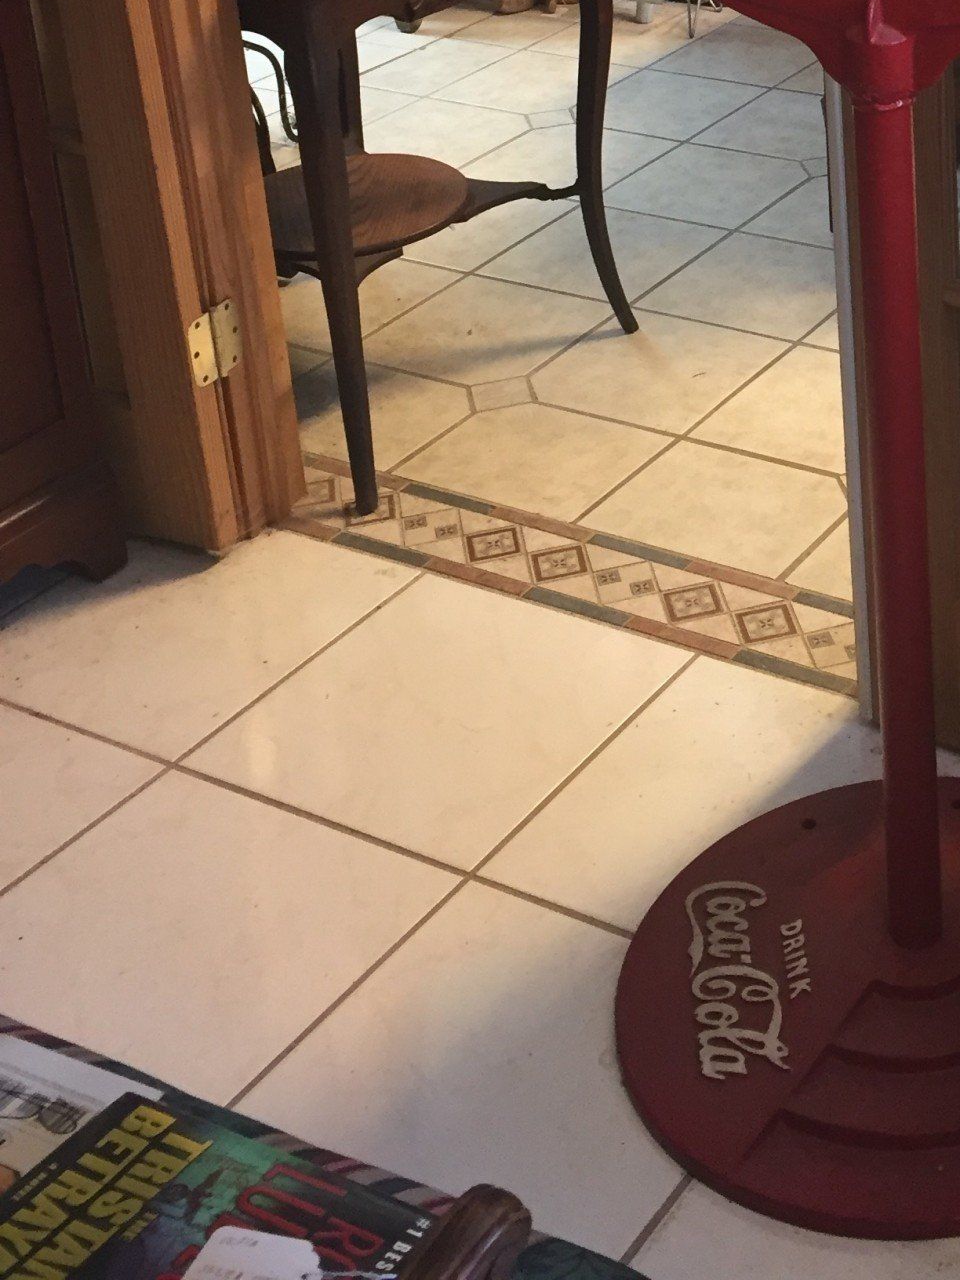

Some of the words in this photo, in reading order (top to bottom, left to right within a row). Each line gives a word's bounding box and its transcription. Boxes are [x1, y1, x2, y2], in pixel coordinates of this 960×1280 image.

[684, 880, 793, 1080] Coca-Cola
[779, 918, 812, 1000] DRINK
[406, 1217, 432, 1238] #1
